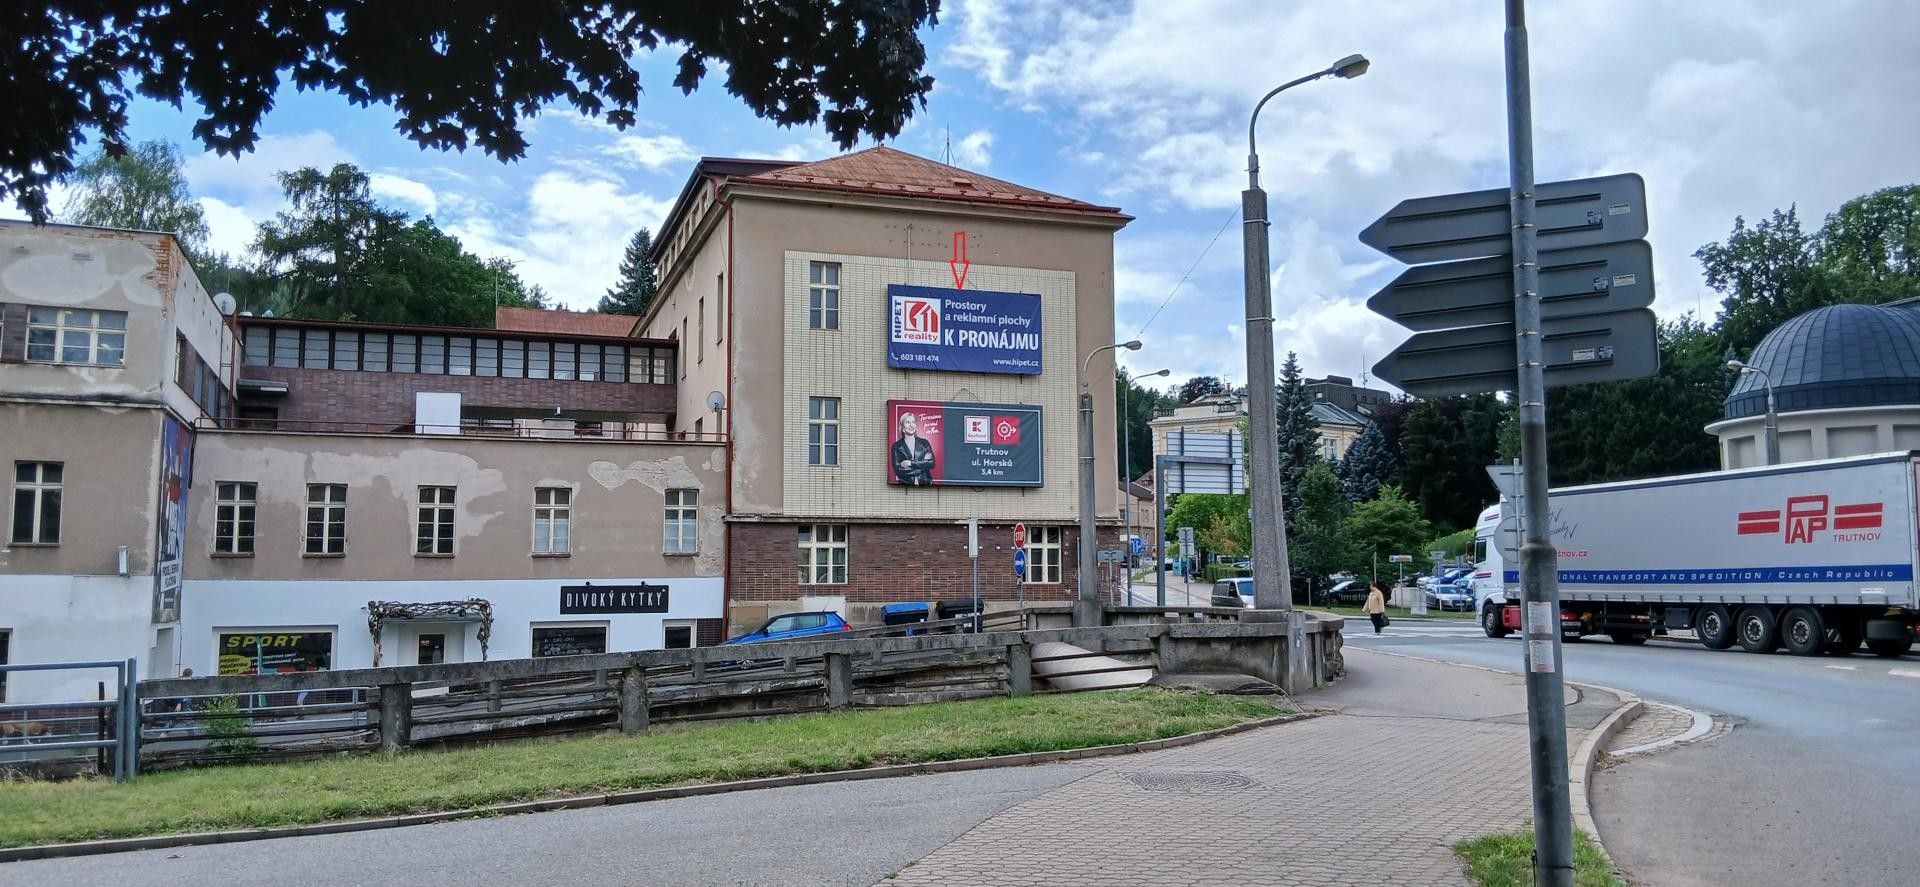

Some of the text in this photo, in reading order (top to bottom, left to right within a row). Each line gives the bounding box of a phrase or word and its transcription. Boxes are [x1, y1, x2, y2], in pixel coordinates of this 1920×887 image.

[945, 299, 987, 313] Prostory
[944, 312, 1031, 328] a reklamní plochy
[904, 333, 938, 342] reality
[944, 328, 1039, 350] K PRONÁJMU
[900, 353, 914, 361] 603
[915, 354, 926, 362] 181
[993, 358, 1039, 367] www.hipet.cz
[976, 447, 1009, 456] Trutnov
[971, 458, 1013, 467] ul. Horská
[981, 468, 992, 476] 3,4
[1833, 532, 1882, 543] TRUTNOV
[1592, 573, 1656, 581] TRANSPORT
[1690, 572, 1761, 580] SPEDITION
[1778, 571, 1819, 579] Czech
[1825, 569, 1894, 580] Republic
[566, 590, 662, 608] DIVOKÝ KYTKY
[226, 635, 302, 648] SPORT
